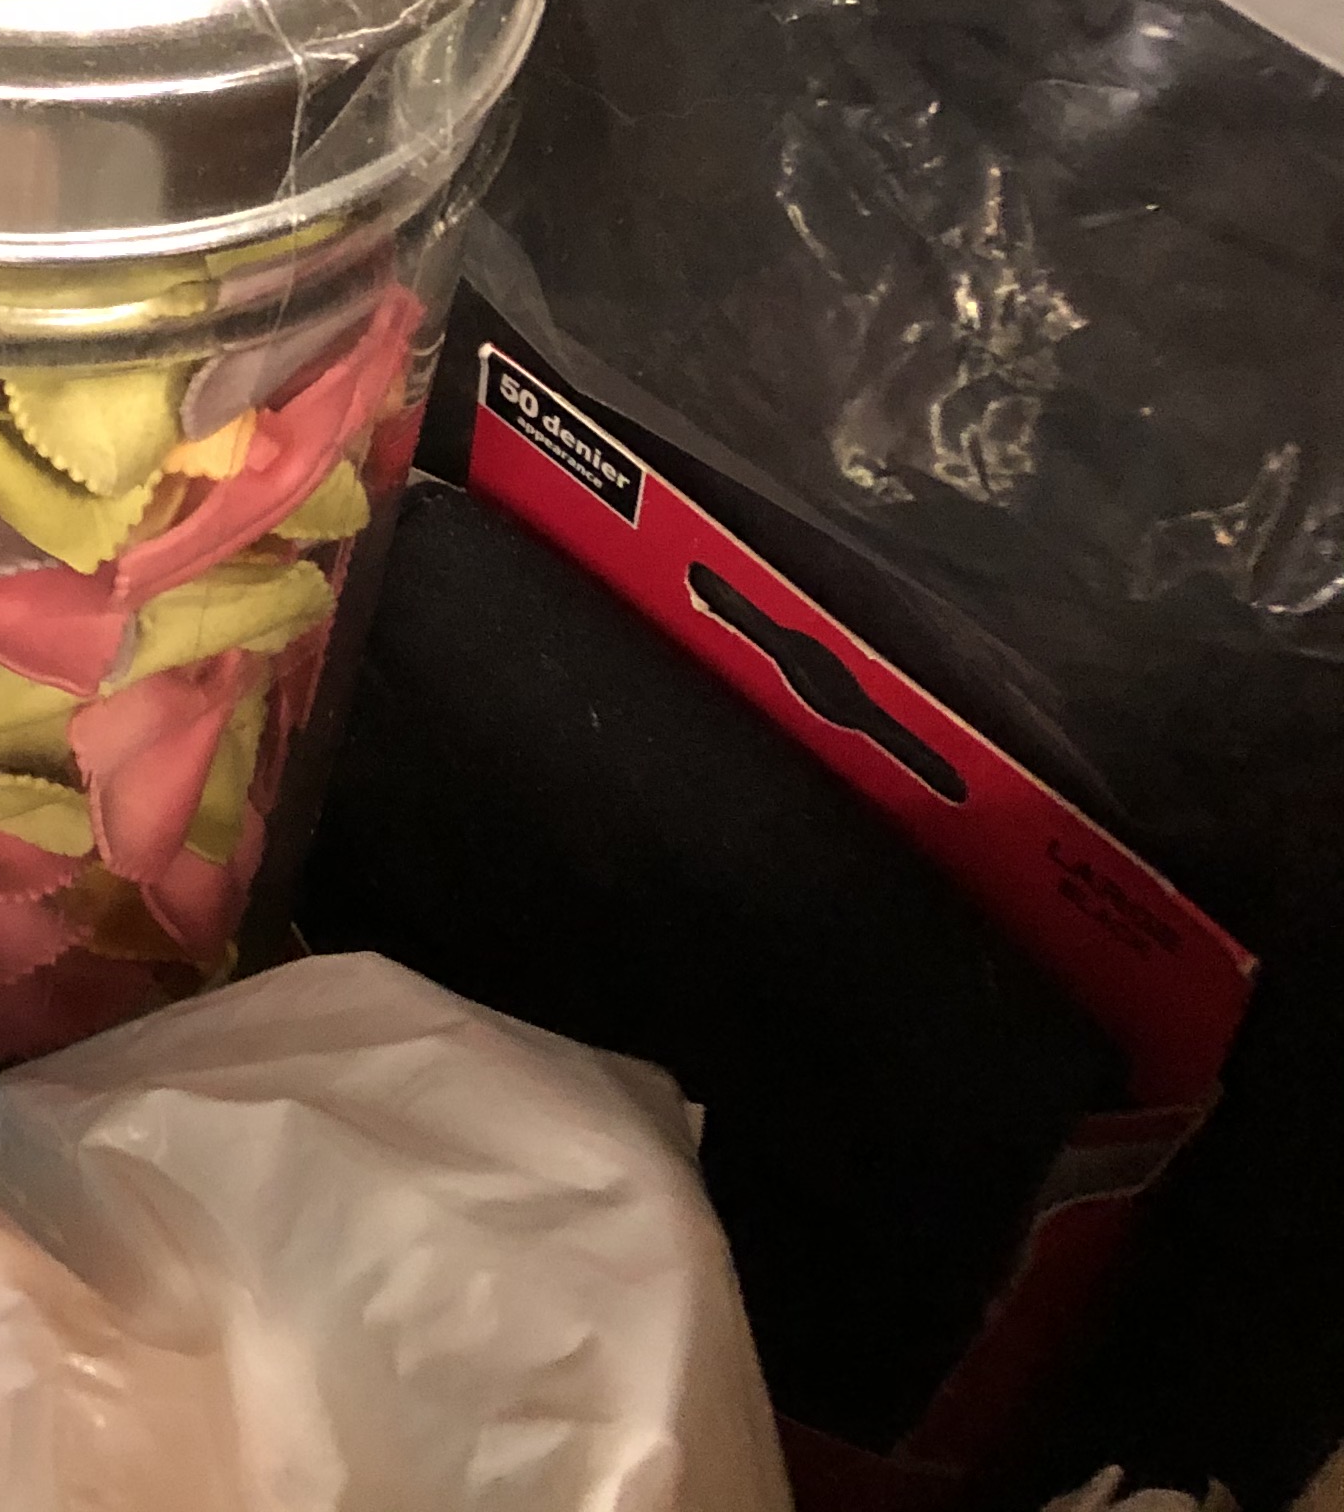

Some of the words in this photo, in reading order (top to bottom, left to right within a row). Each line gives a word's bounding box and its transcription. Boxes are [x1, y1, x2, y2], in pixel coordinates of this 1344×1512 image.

[499, 373, 539, 419] 50
[541, 414, 631, 489] denier
[516, 415, 603, 489] appearance
